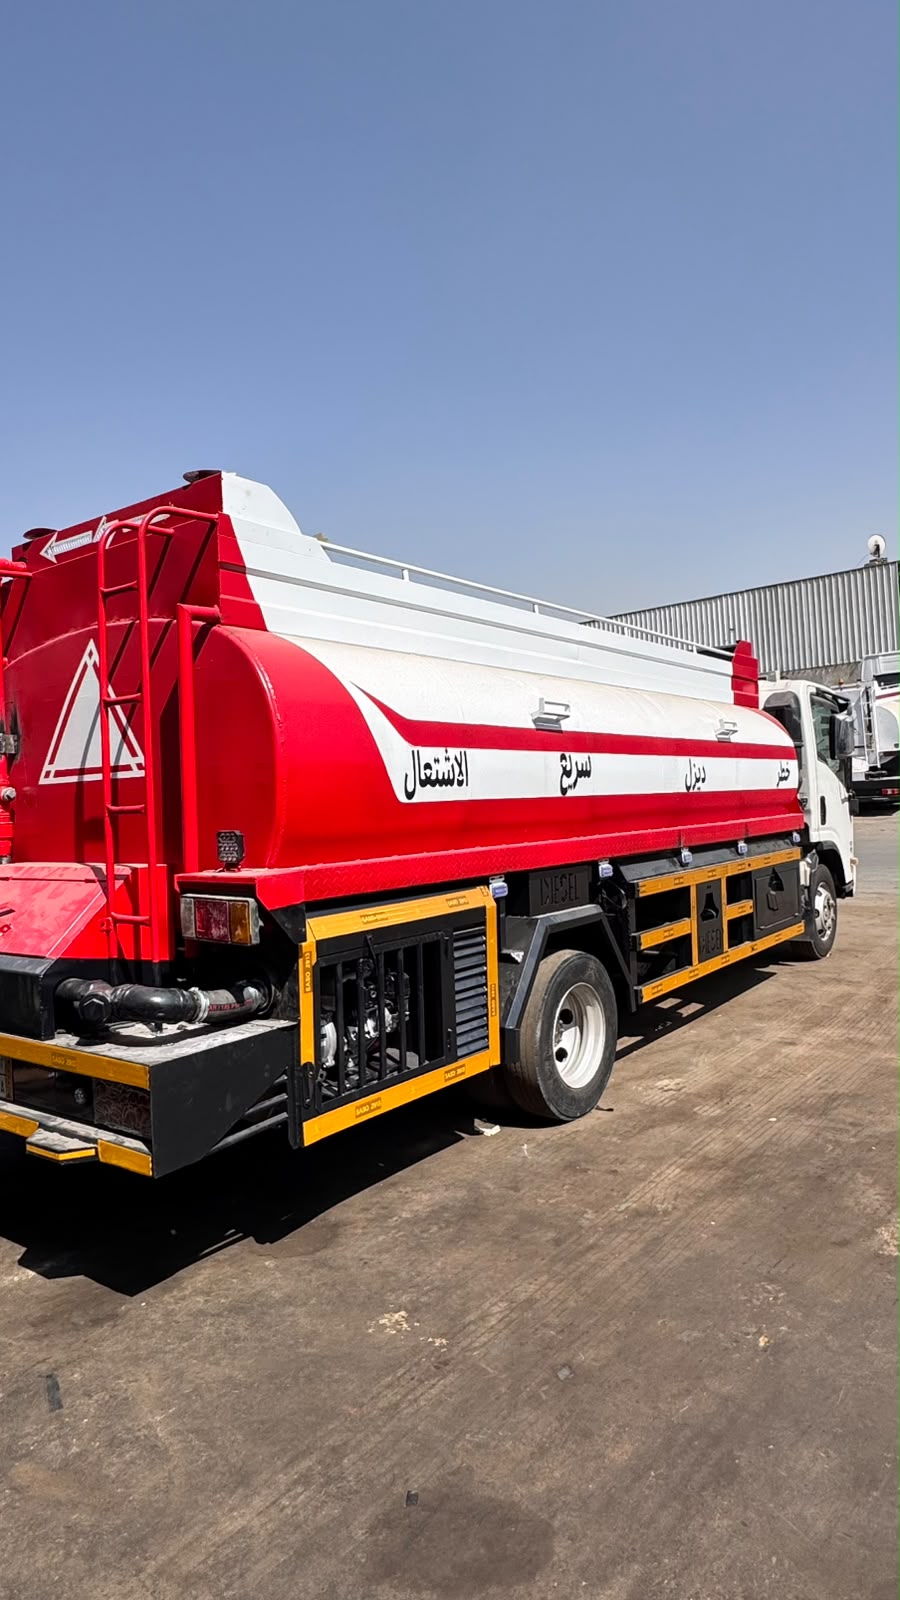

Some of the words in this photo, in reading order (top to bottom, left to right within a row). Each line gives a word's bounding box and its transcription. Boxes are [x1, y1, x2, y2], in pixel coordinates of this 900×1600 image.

[404, 748, 469, 801] الاشتعال
[560, 753, 592, 796] سريع
[685, 758, 706, 793] ديزل
[776, 760, 790, 788] خطر
